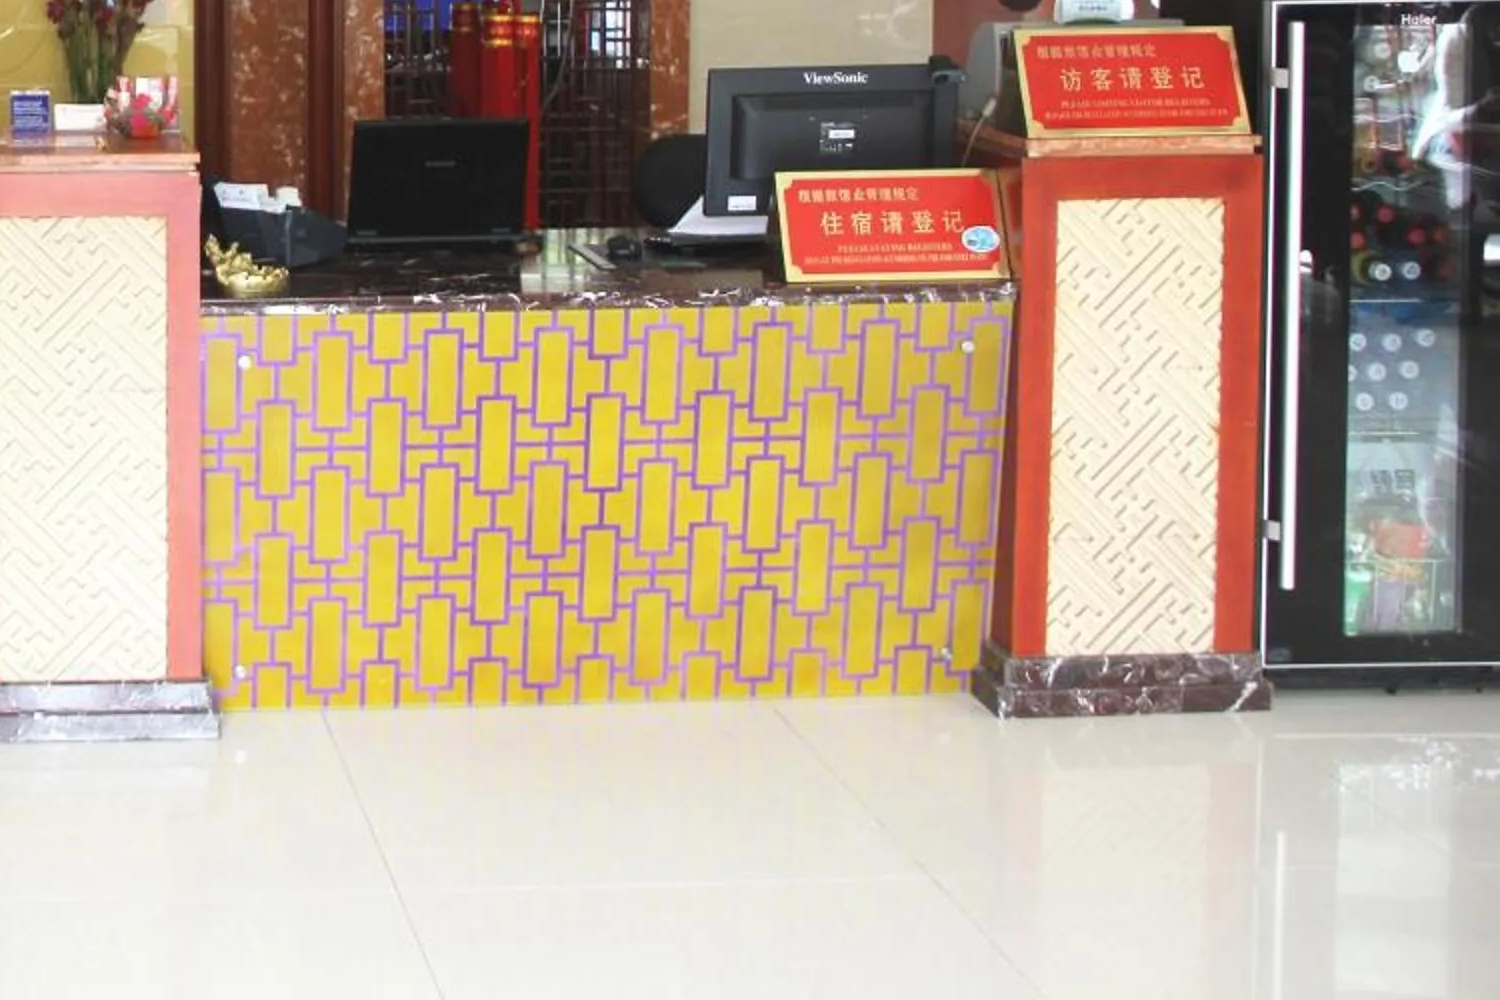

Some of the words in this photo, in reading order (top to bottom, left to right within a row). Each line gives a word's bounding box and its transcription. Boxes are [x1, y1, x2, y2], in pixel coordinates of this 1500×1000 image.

[1400, 13, 1437, 25] Haier
[803, 71, 869, 85] ViewSonic
[1060, 64, 1205, 92] 访客请登记
[820, 209, 965, 237] 住宿请登记
